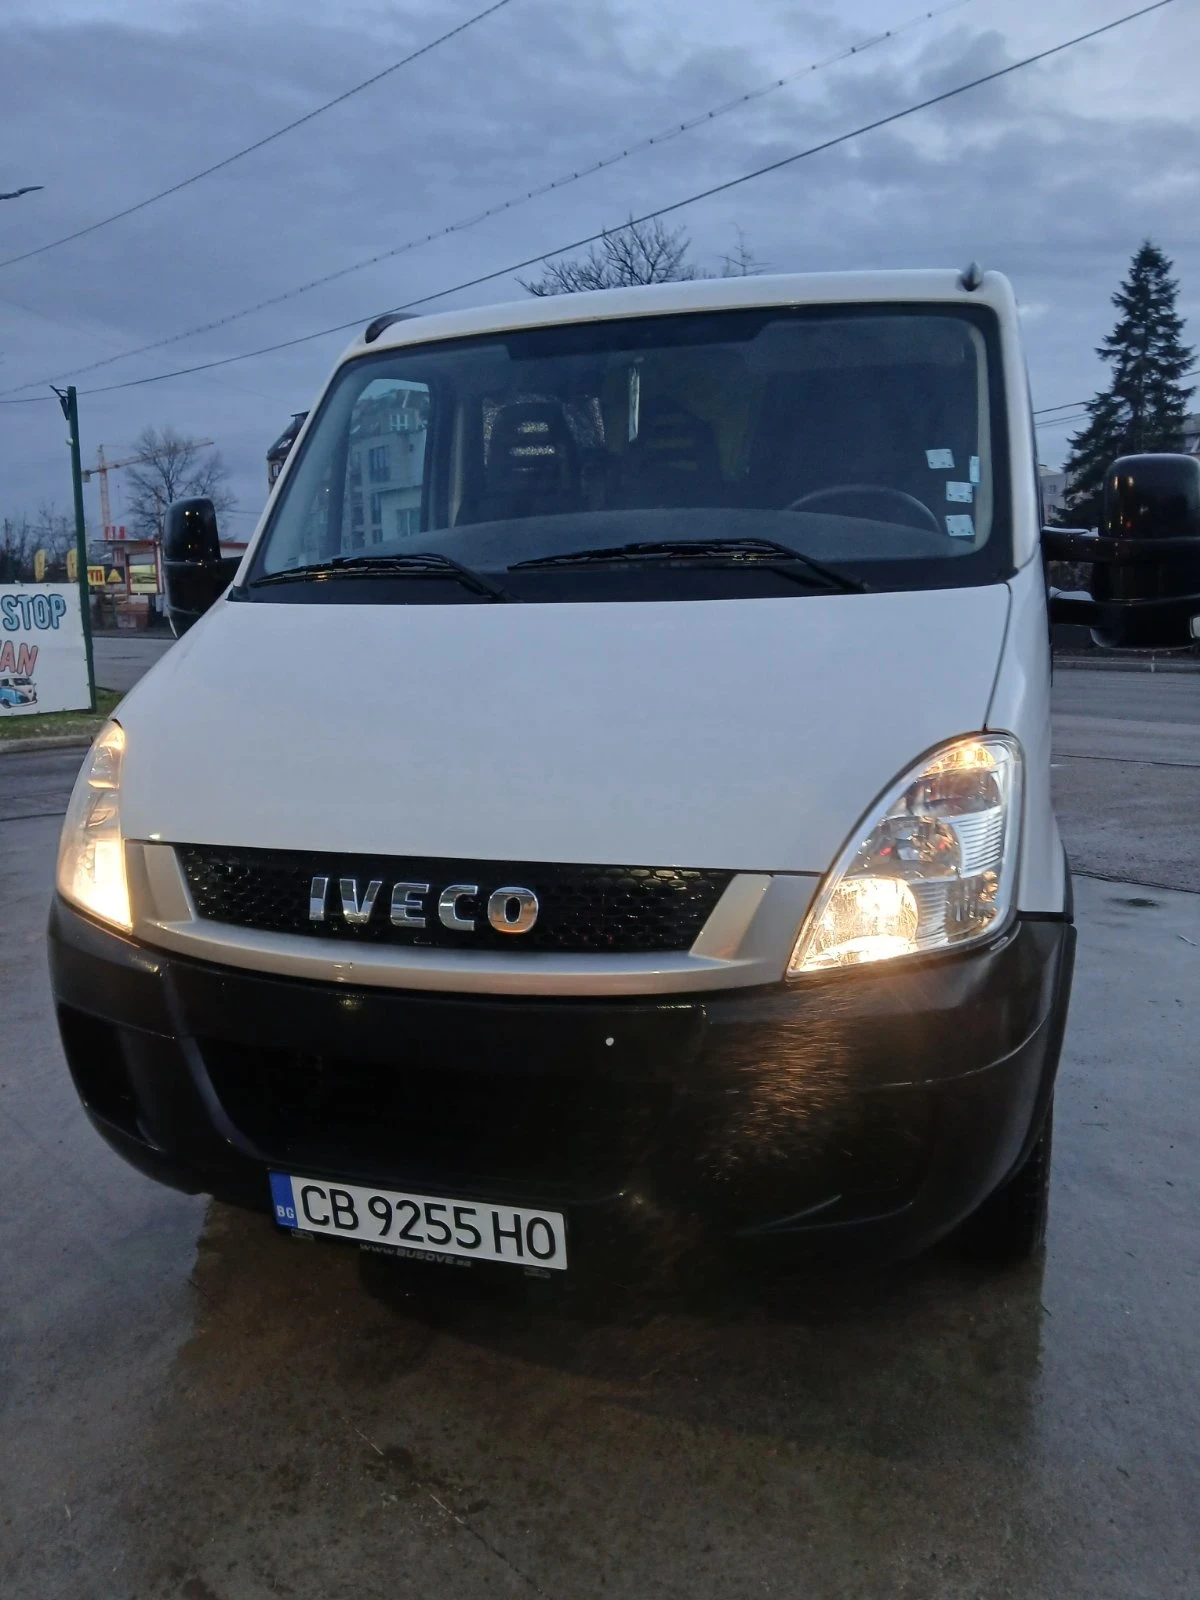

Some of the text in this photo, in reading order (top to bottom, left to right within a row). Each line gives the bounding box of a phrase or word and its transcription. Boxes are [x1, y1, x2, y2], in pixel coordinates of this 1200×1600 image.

[1, 594, 66, 631] STOP
[0, 640, 39, 676] AN
[309, 877, 539, 934] IVECO
[276, 1204, 295, 1219] BG
